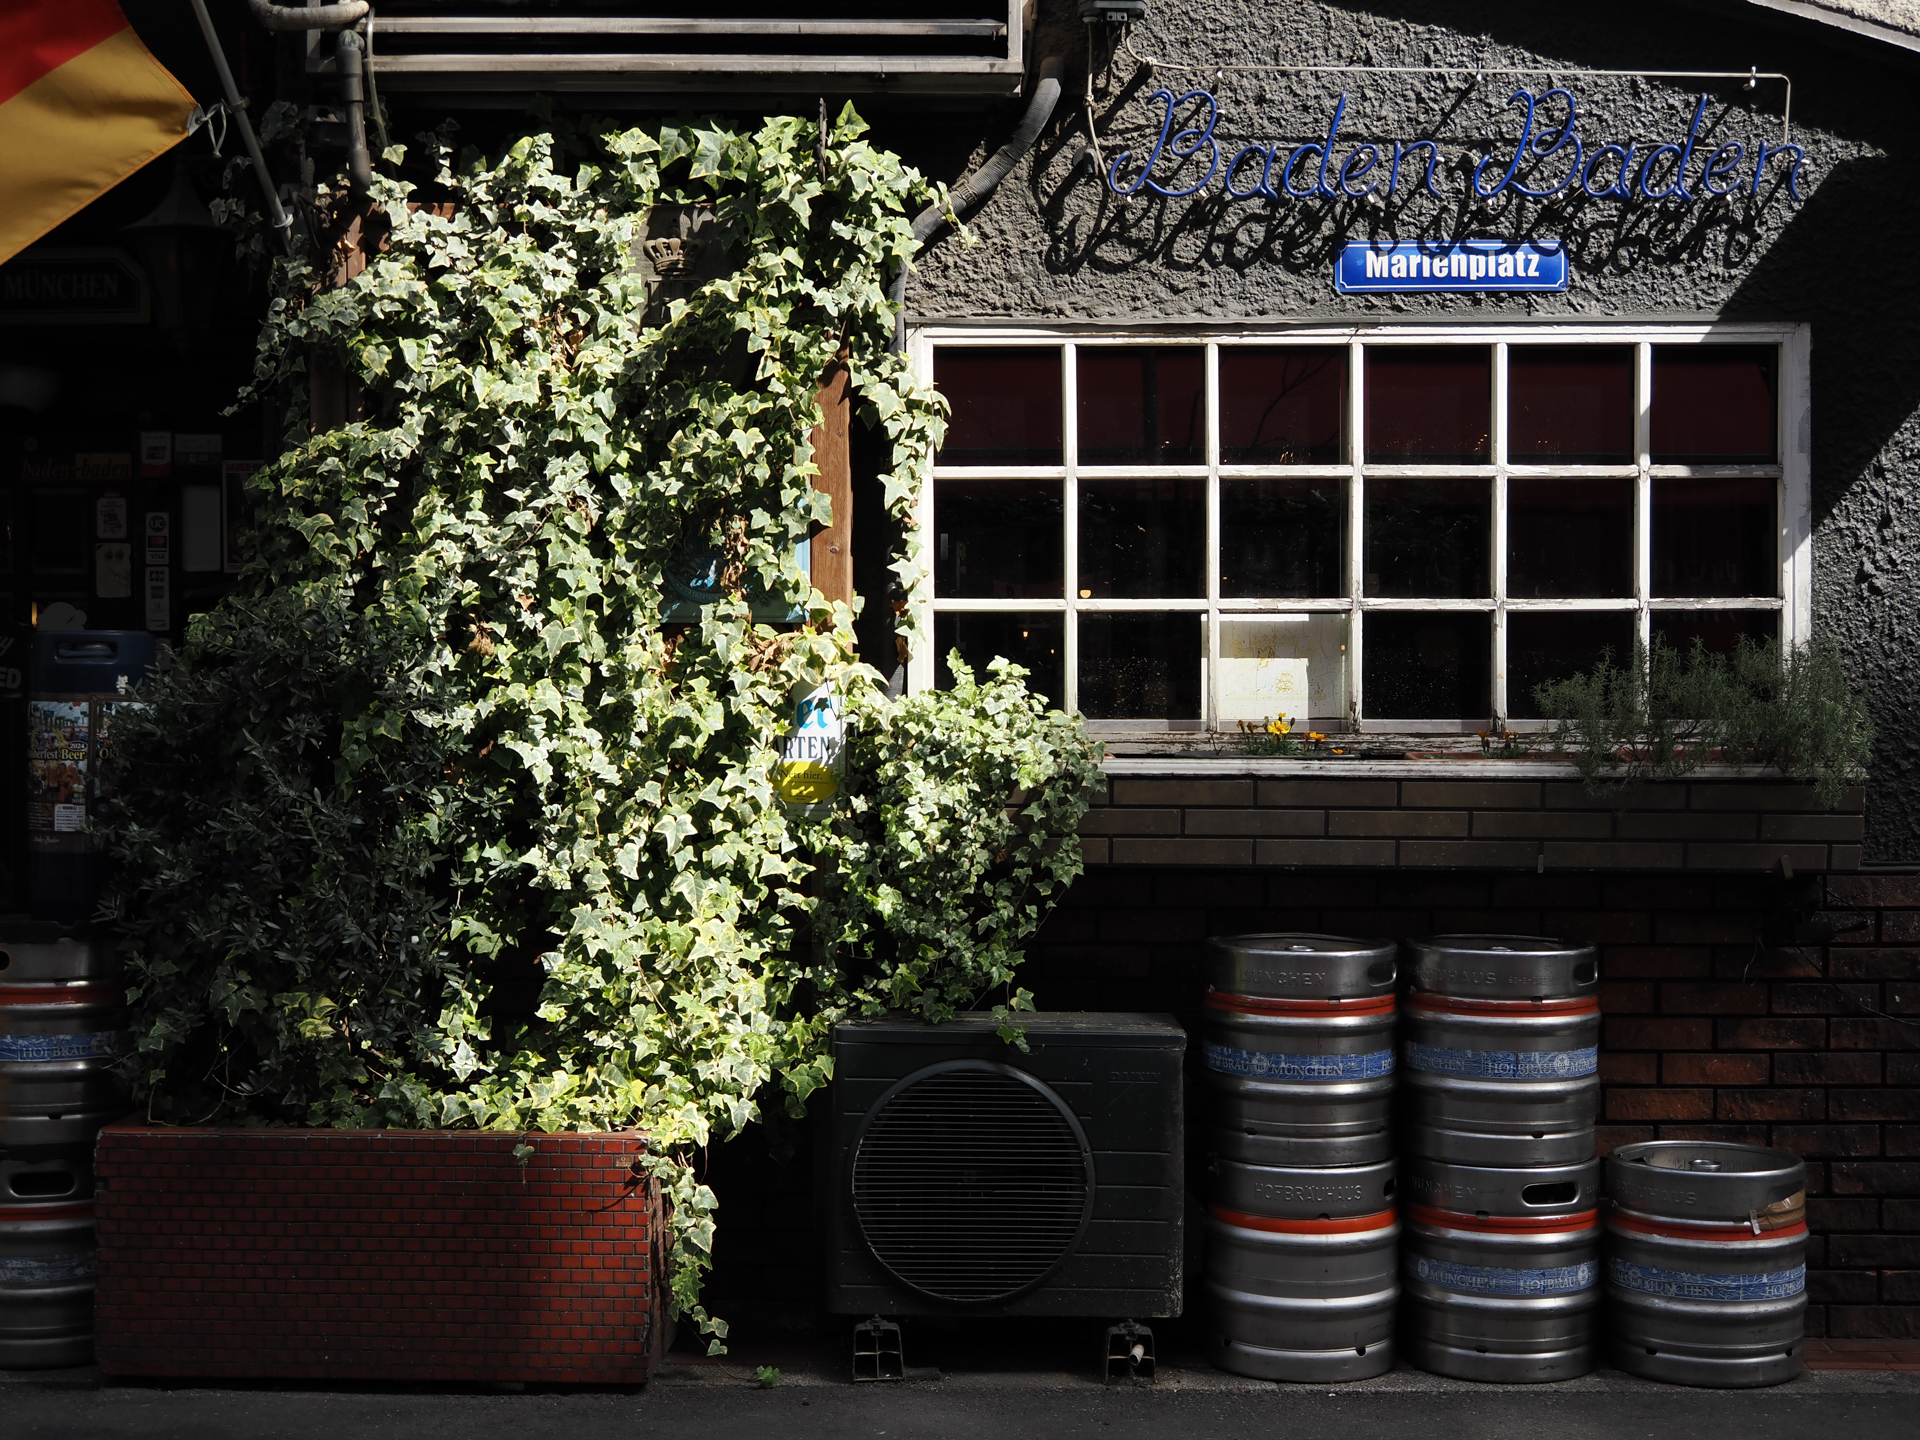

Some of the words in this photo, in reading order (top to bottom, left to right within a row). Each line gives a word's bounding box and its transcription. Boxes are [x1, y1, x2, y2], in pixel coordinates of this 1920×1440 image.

[1109, 88, 1441, 201] Baden
[1473, 88, 1804, 201] Baden
[1366, 249, 1540, 281] Marienplatz
[4, 270, 119, 300] MÜNCHEN
[61, 749, 85, 760] Beer
[803, 771, 823, 780] hier.
[23, 1042, 87, 1059] HOFBRÄU
[1255, 1182, 1362, 1203] HOFBRÄUHAUS
